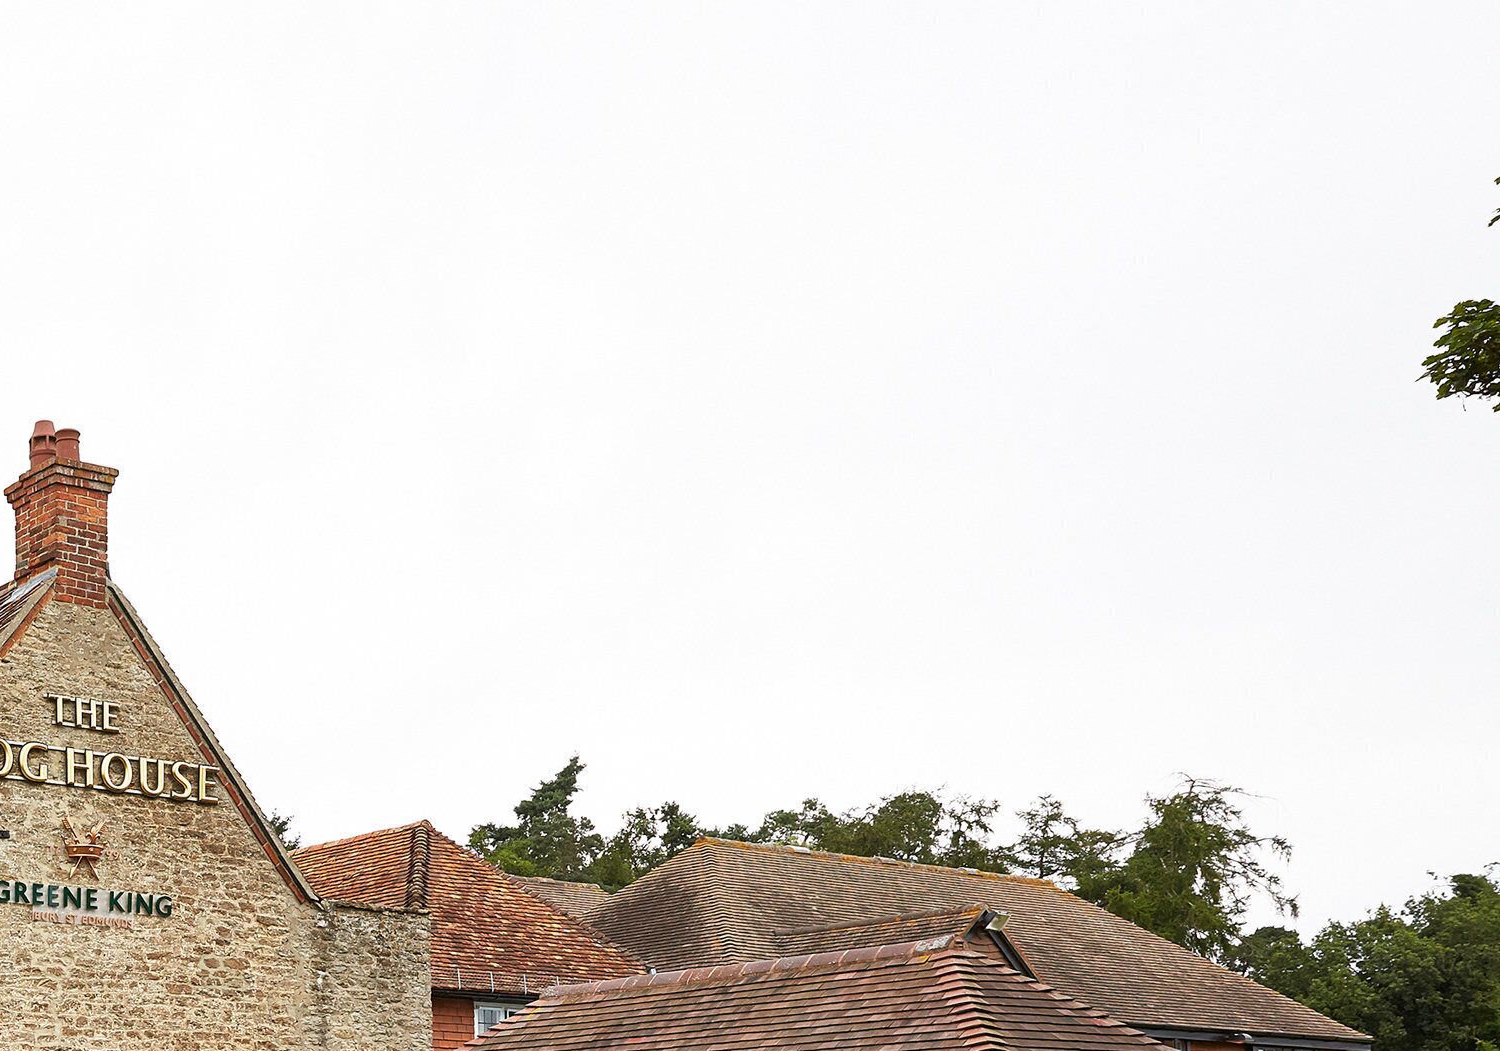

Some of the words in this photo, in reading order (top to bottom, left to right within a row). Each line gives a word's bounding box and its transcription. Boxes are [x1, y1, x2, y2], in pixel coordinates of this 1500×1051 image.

[46, 693, 121, 732] THE
[64, 747, 220, 803] HOUSE
[108, 890, 172, 918] KING
